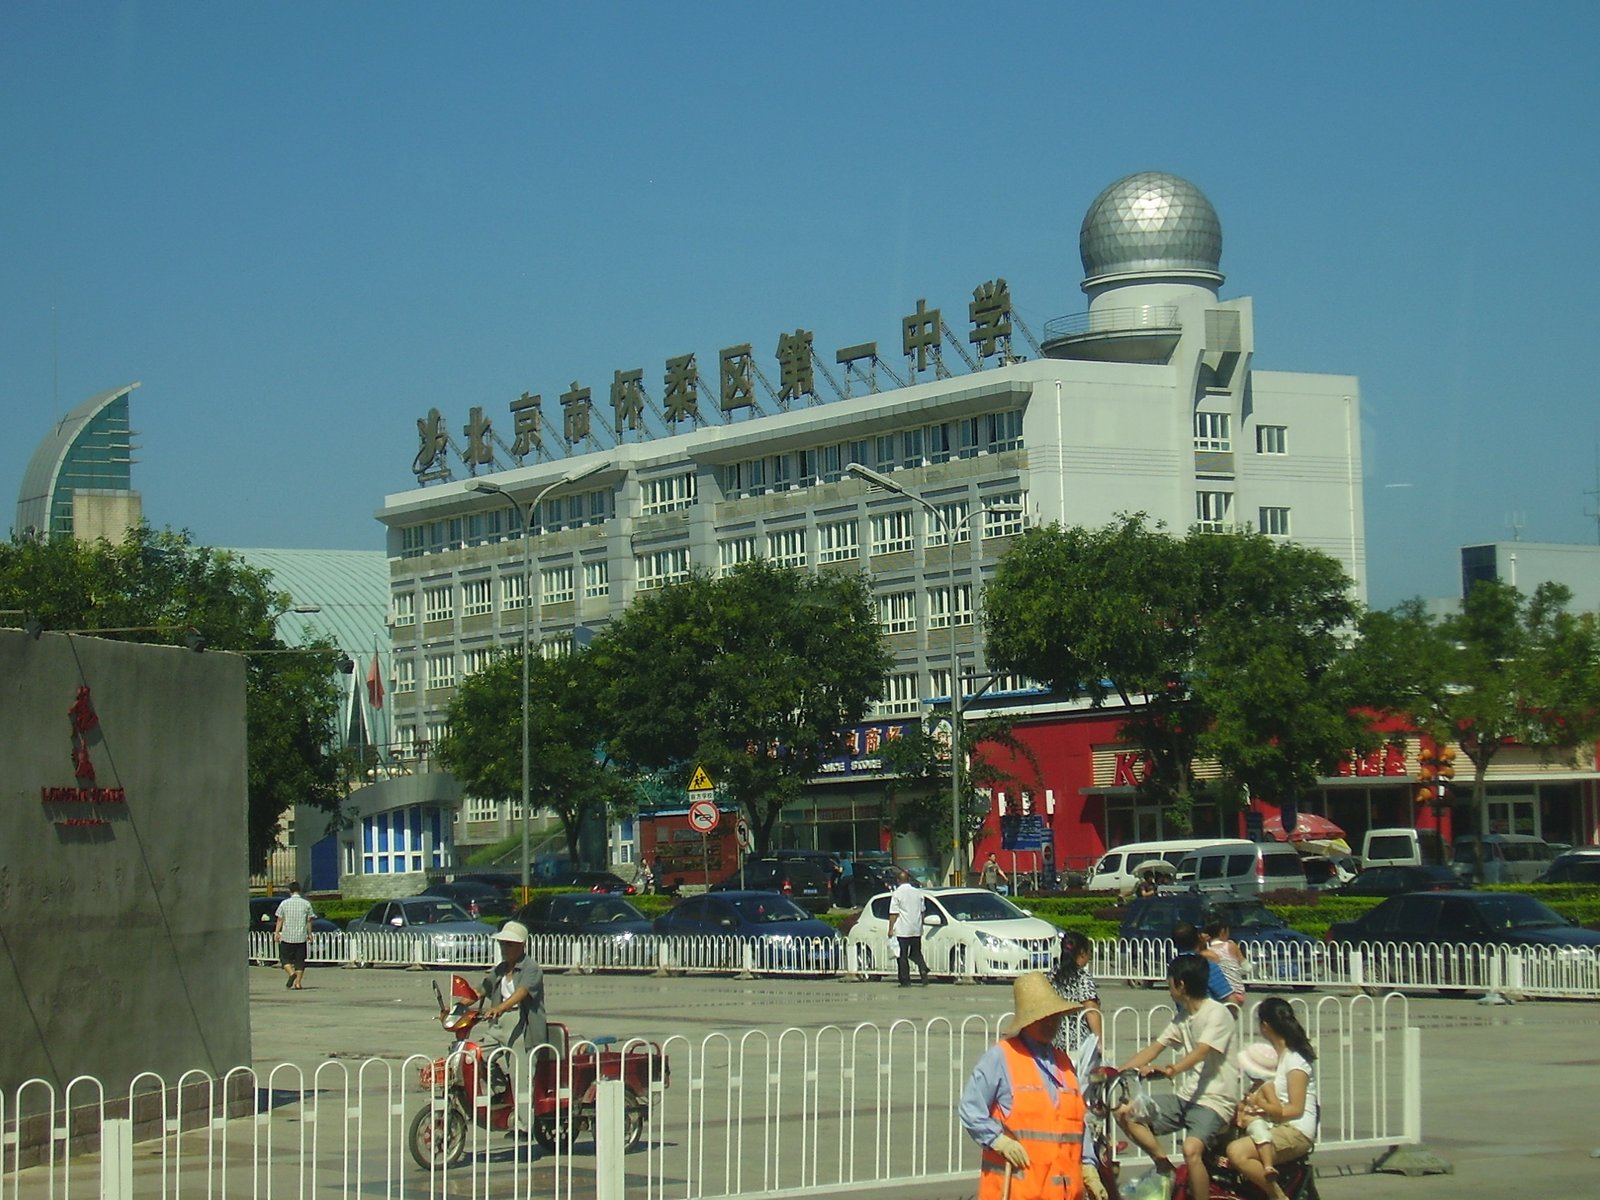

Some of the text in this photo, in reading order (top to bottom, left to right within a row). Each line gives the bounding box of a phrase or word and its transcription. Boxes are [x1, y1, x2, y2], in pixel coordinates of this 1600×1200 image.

[462, 277, 1011, 465] 北京市怀柔区第一中学
